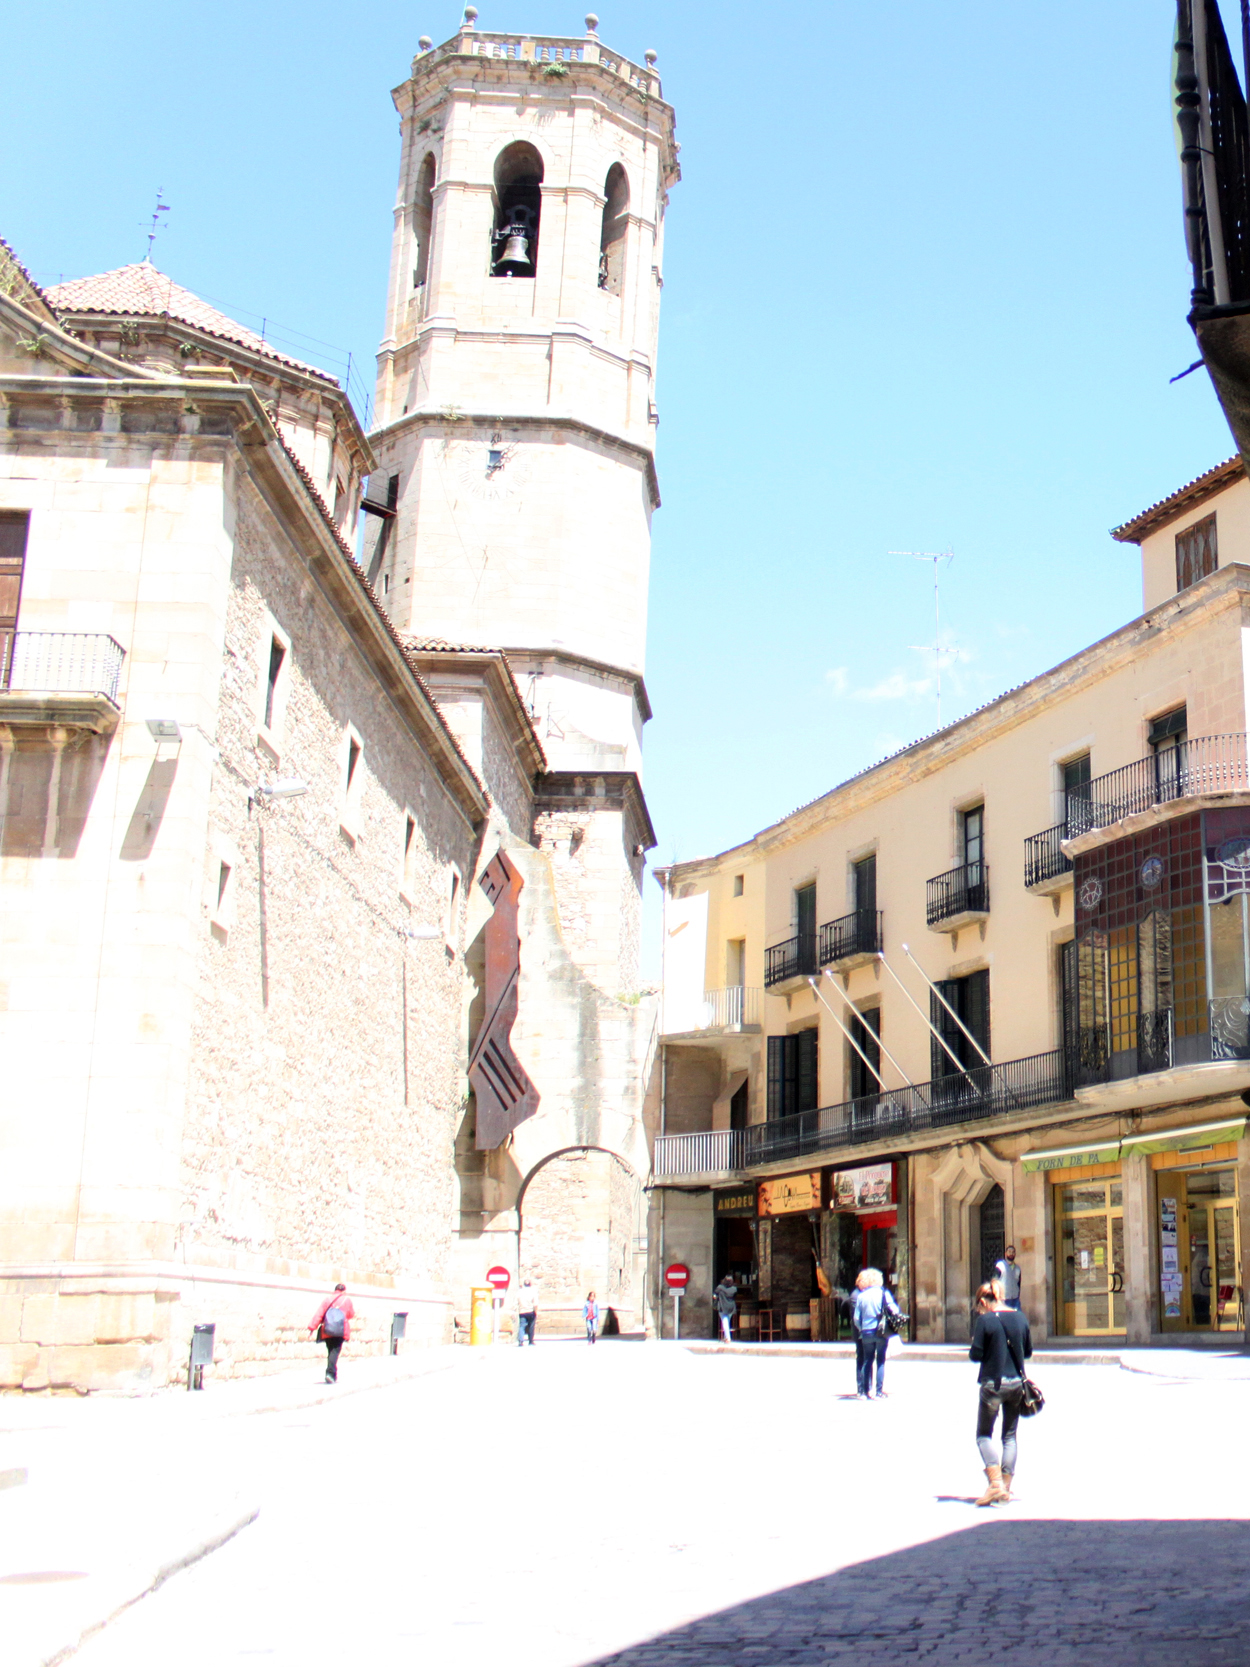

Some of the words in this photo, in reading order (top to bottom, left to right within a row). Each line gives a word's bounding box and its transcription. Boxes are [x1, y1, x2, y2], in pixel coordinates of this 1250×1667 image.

[1037, 1156, 1064, 1169] FORN
[1069, 1154, 1083, 1166] DE
[1087, 1153, 1100, 1164] PA
[718, 1194, 754, 1211] ANDREU
